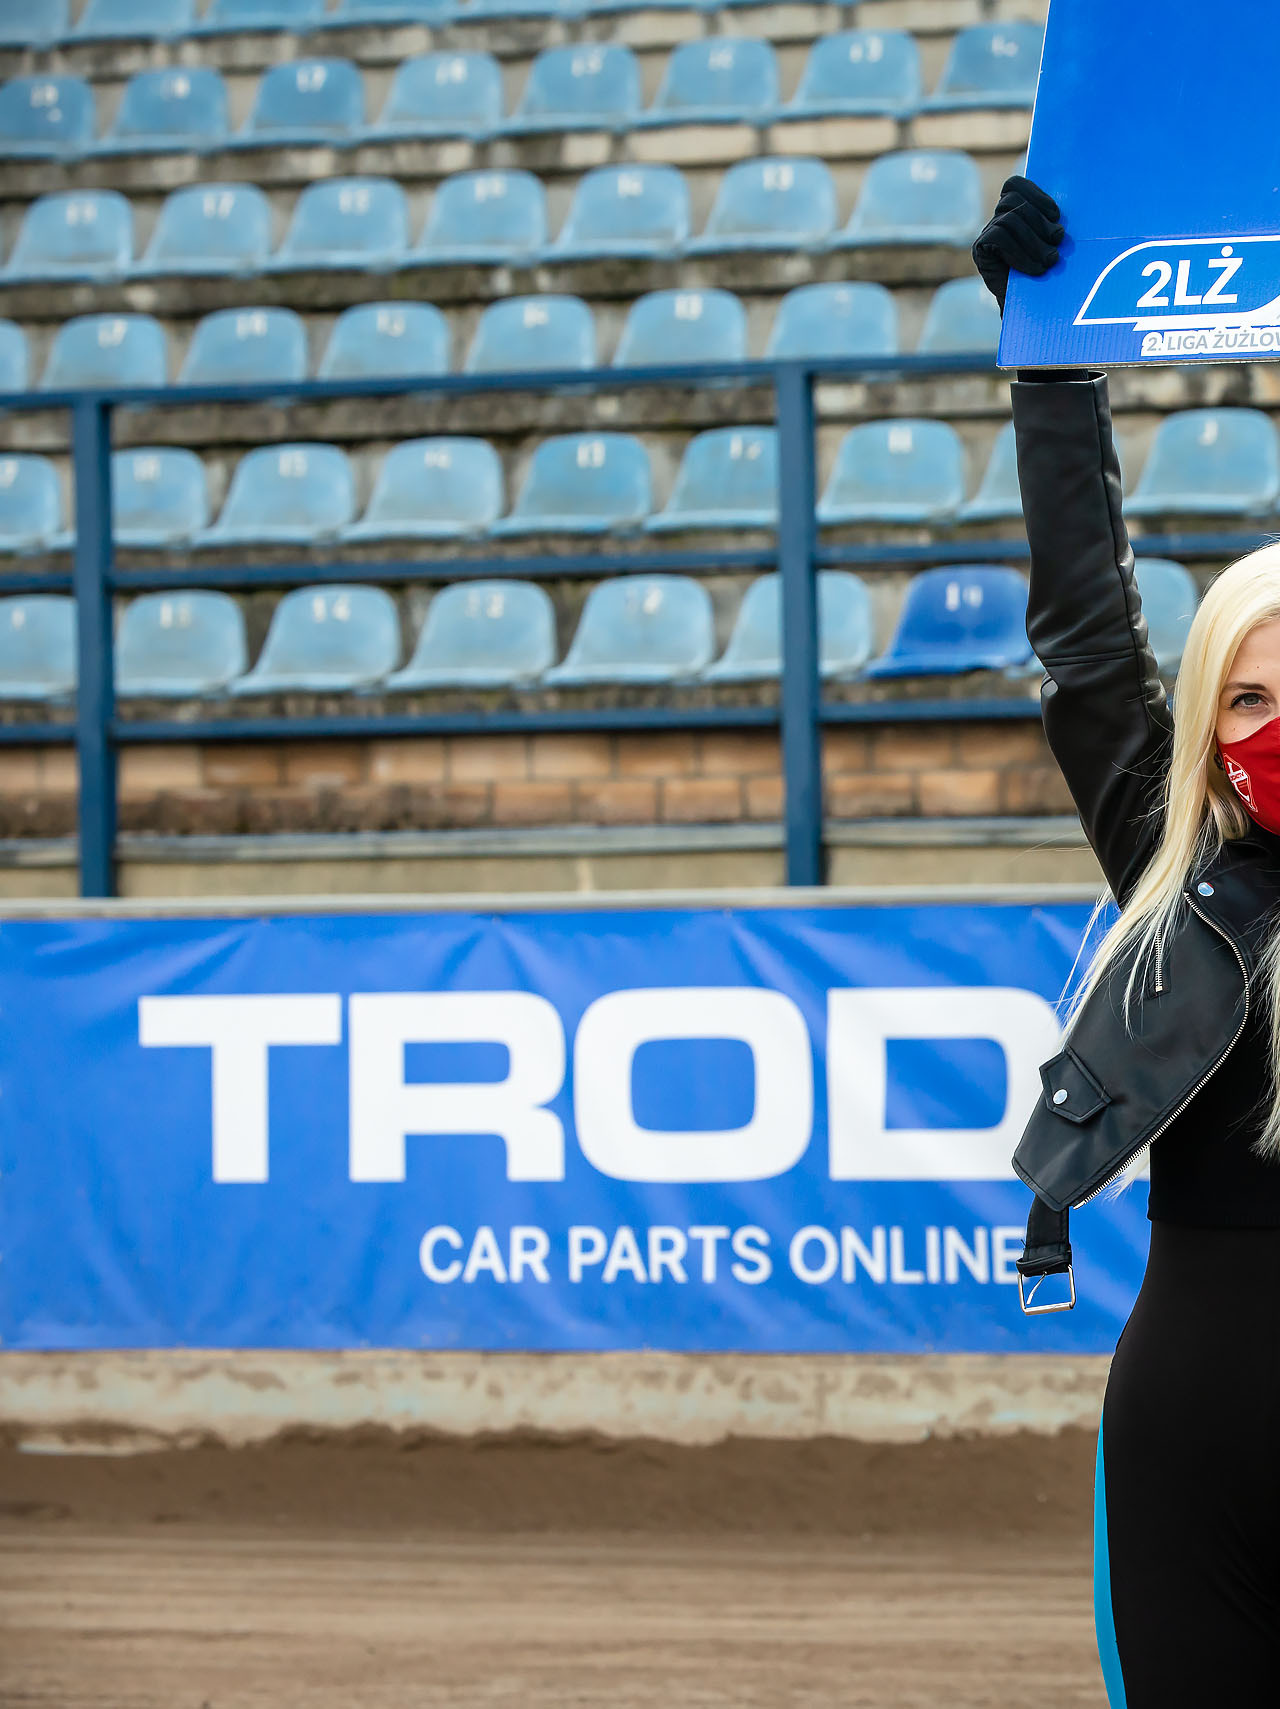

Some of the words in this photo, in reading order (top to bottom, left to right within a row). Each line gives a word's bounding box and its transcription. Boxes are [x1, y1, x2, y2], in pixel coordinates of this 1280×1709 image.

[1136, 245, 1244, 308] 2LŻ
[1147, 336, 1162, 352] 2.
[1167, 334, 1208, 351] LIGA
[139, 985, 1064, 1183] TROD
[418, 1224, 550, 1285] CAR
[570, 1224, 772, 1285] PARTS
[789, 1224, 1026, 1285] ONLINE
